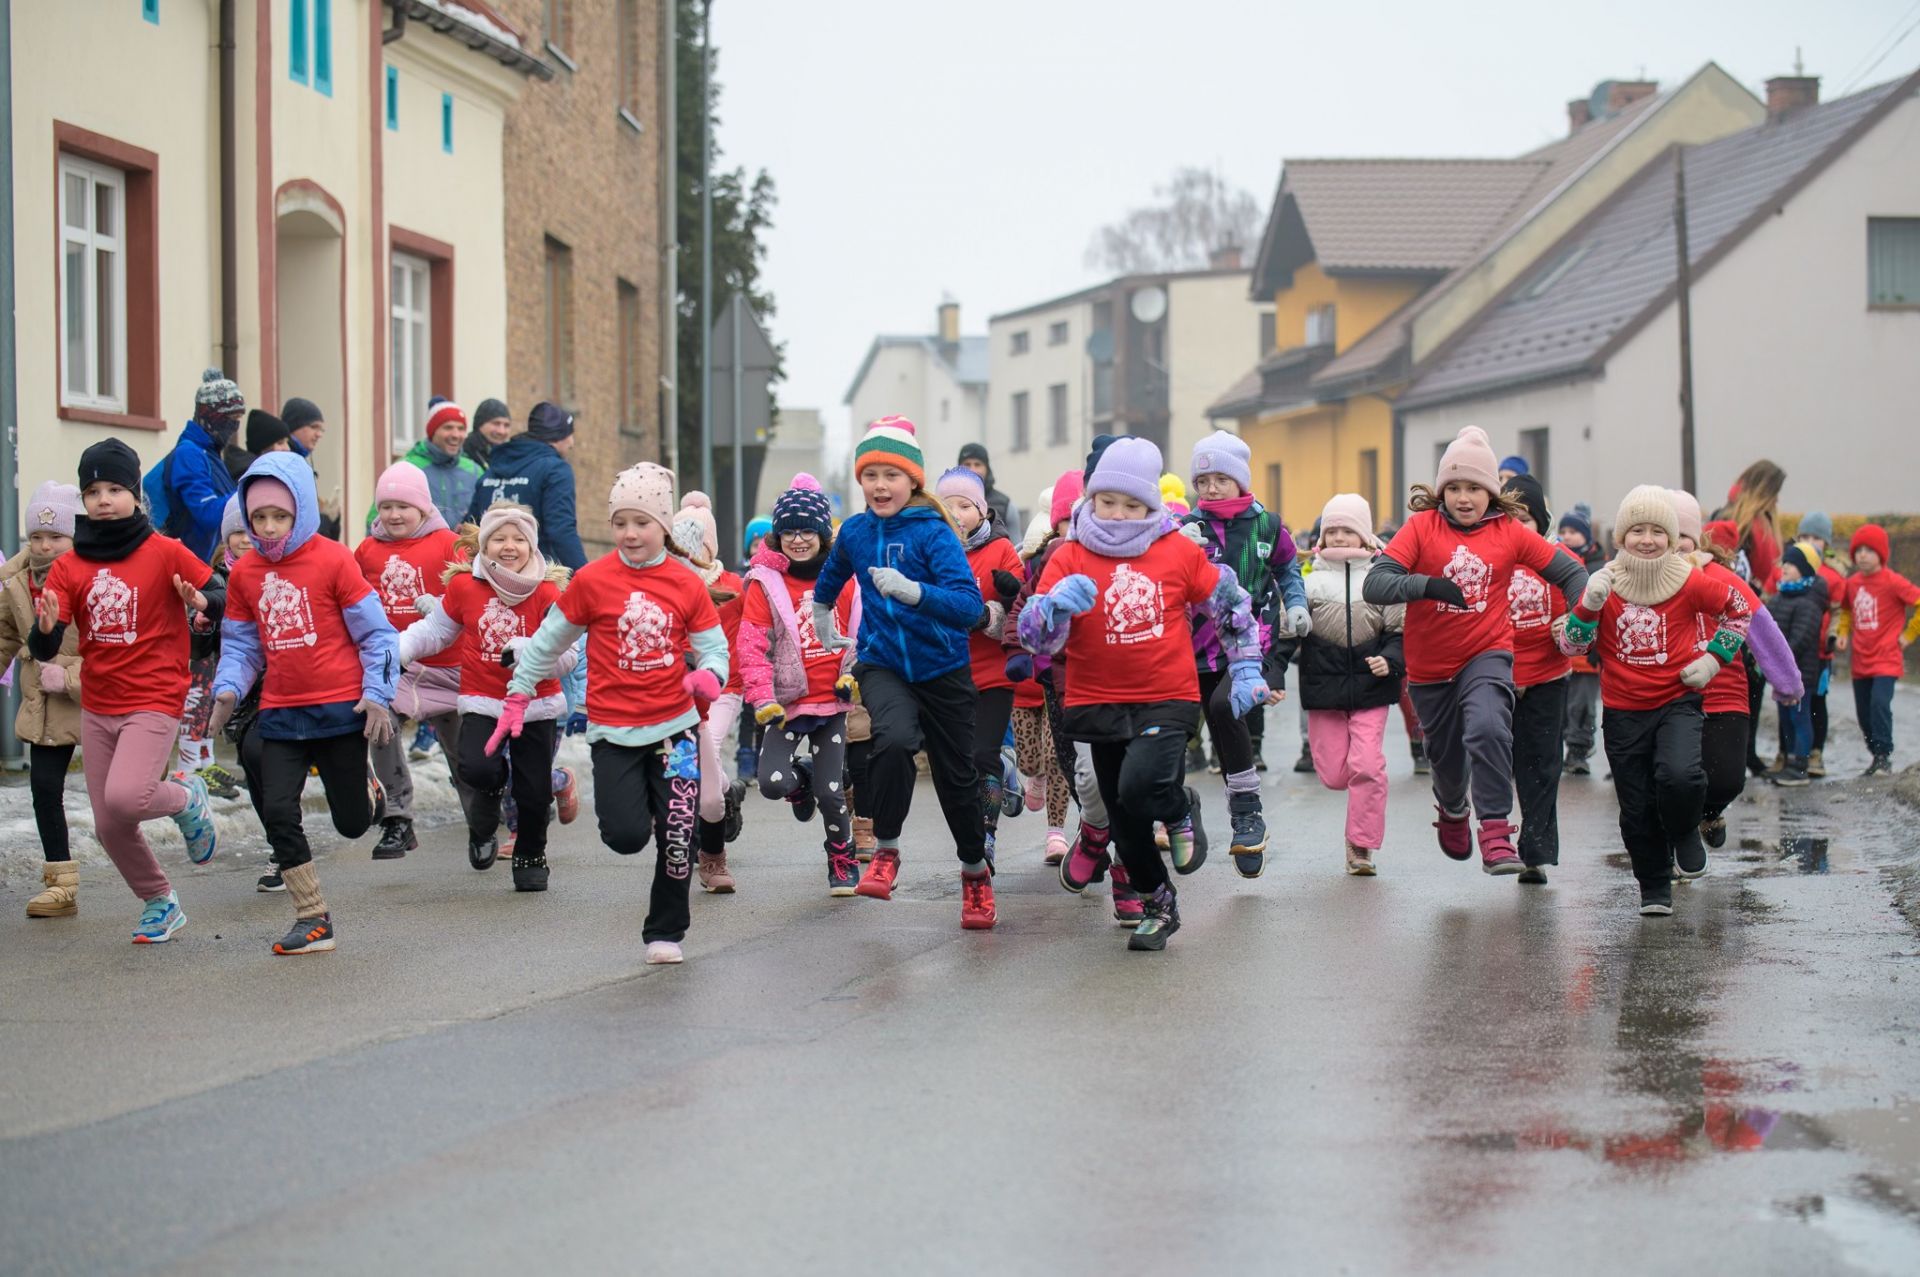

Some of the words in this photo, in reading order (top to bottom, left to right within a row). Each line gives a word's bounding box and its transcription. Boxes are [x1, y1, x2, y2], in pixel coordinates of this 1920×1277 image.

[1105, 633, 1117, 644] 12
[618, 659, 629, 670] 12
[665, 778, 698, 880] STITCH
